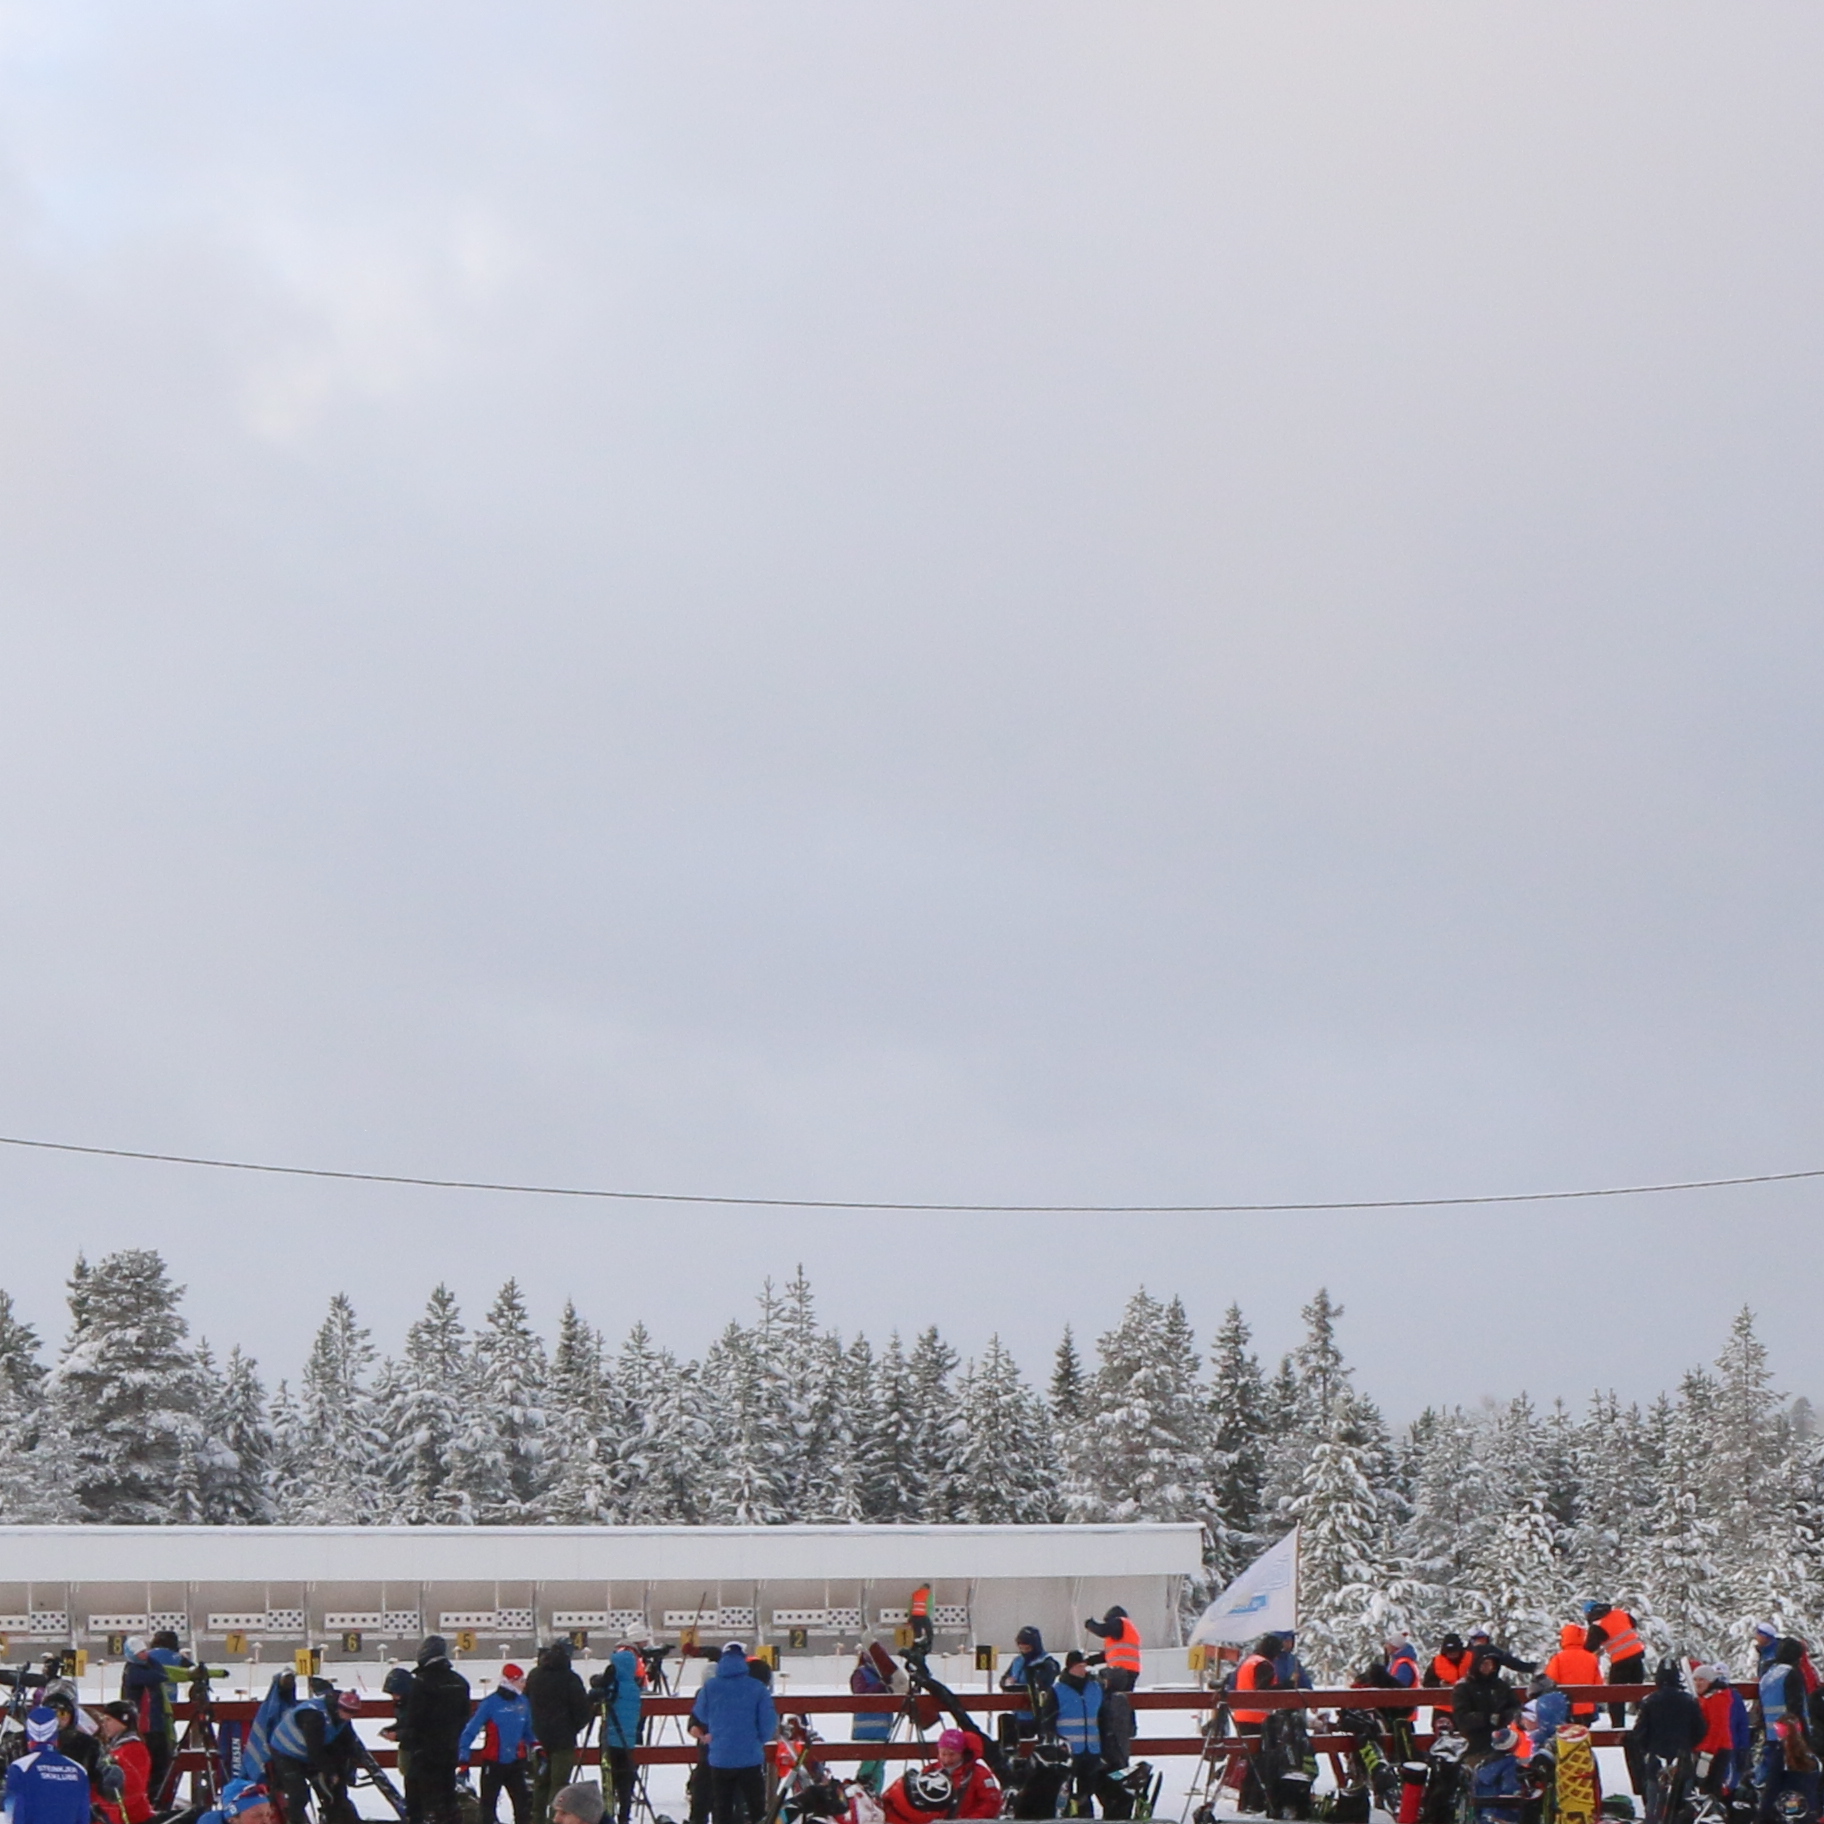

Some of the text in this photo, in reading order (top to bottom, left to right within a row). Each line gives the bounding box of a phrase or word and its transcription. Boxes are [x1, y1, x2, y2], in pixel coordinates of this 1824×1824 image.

[113, 1638, 121, 1653] 8
[233, 1636, 240, 1652] 7
[348, 1634, 357, 1652] 6
[462, 1633, 470, 1650] 5
[573, 1633, 583, 1649] 4
[795, 1631, 802, 1647] 2
[1193, 1654, 1199, 1669] 7
